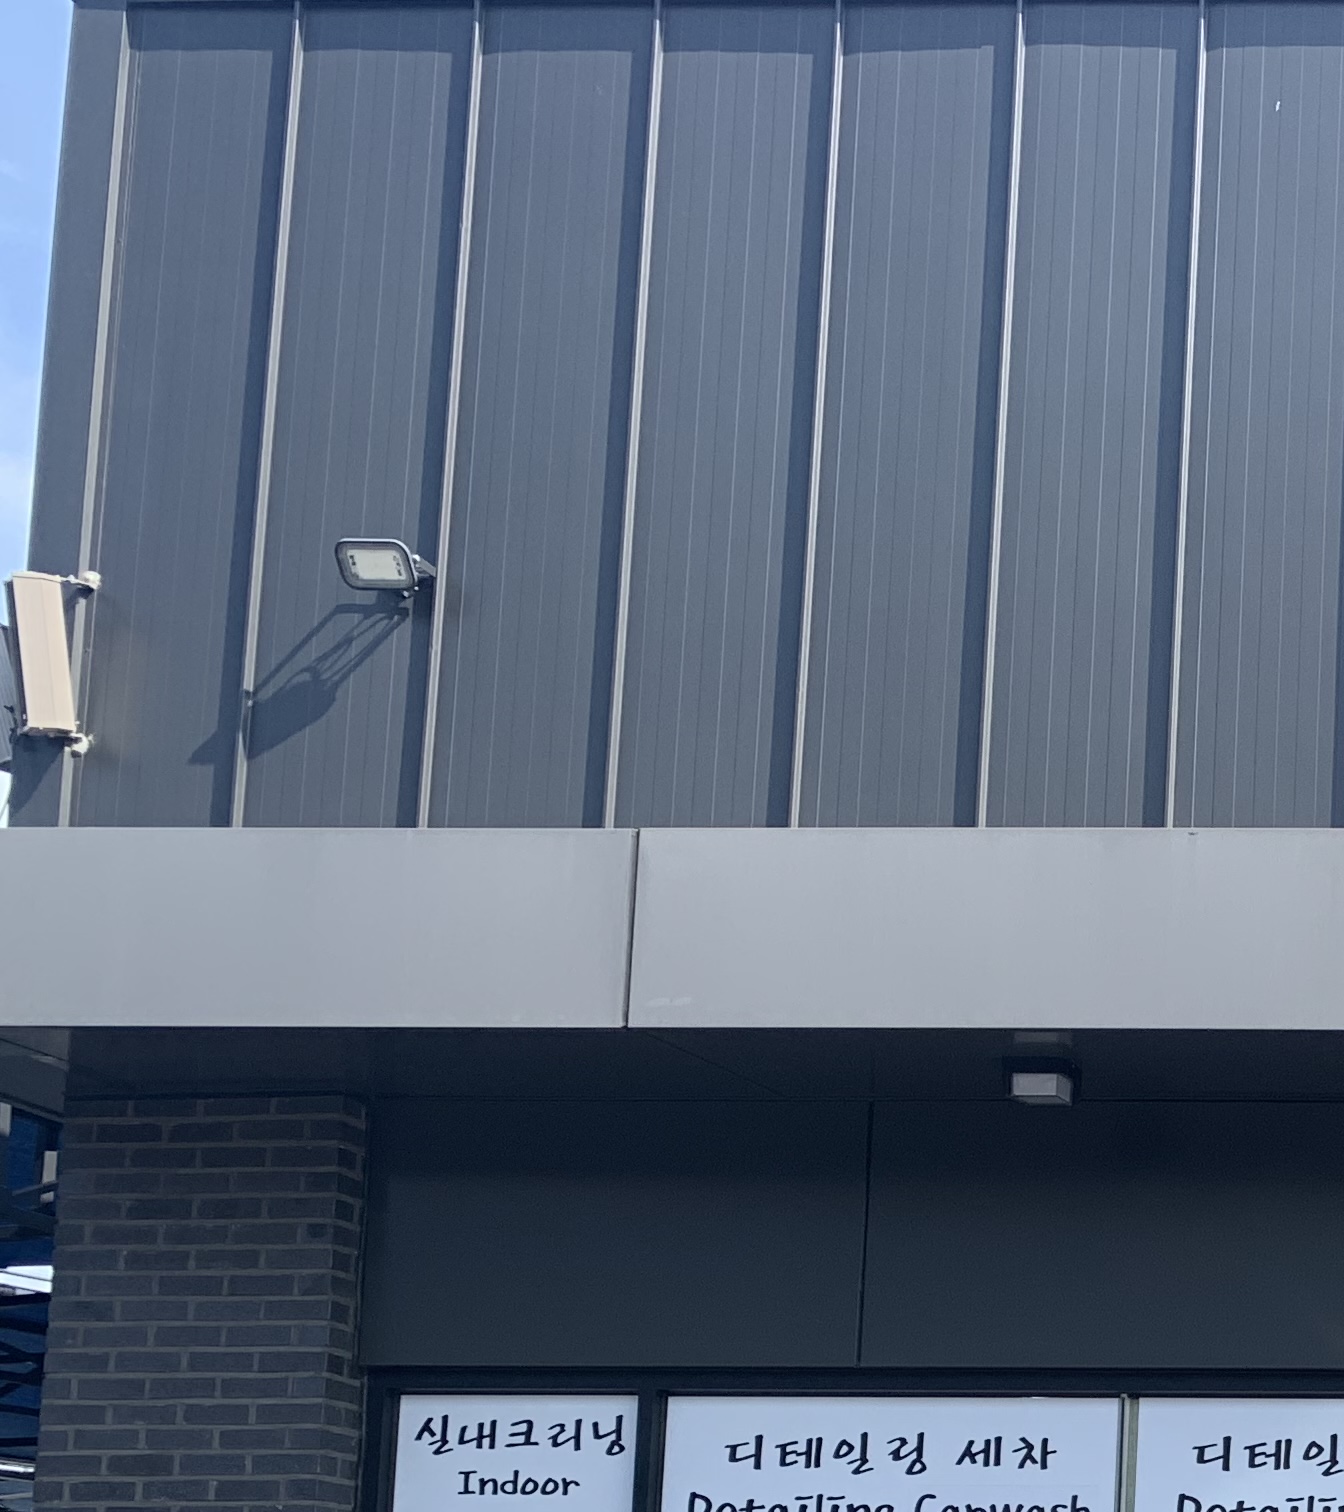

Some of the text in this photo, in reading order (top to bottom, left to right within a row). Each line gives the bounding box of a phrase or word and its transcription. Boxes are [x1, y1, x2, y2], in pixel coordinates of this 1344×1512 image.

[415, 1415, 625, 1456] 실내크리닝
[725, 1432, 1057, 1475] 디테일링 세차
[458, 1470, 580, 1495] Indoor
